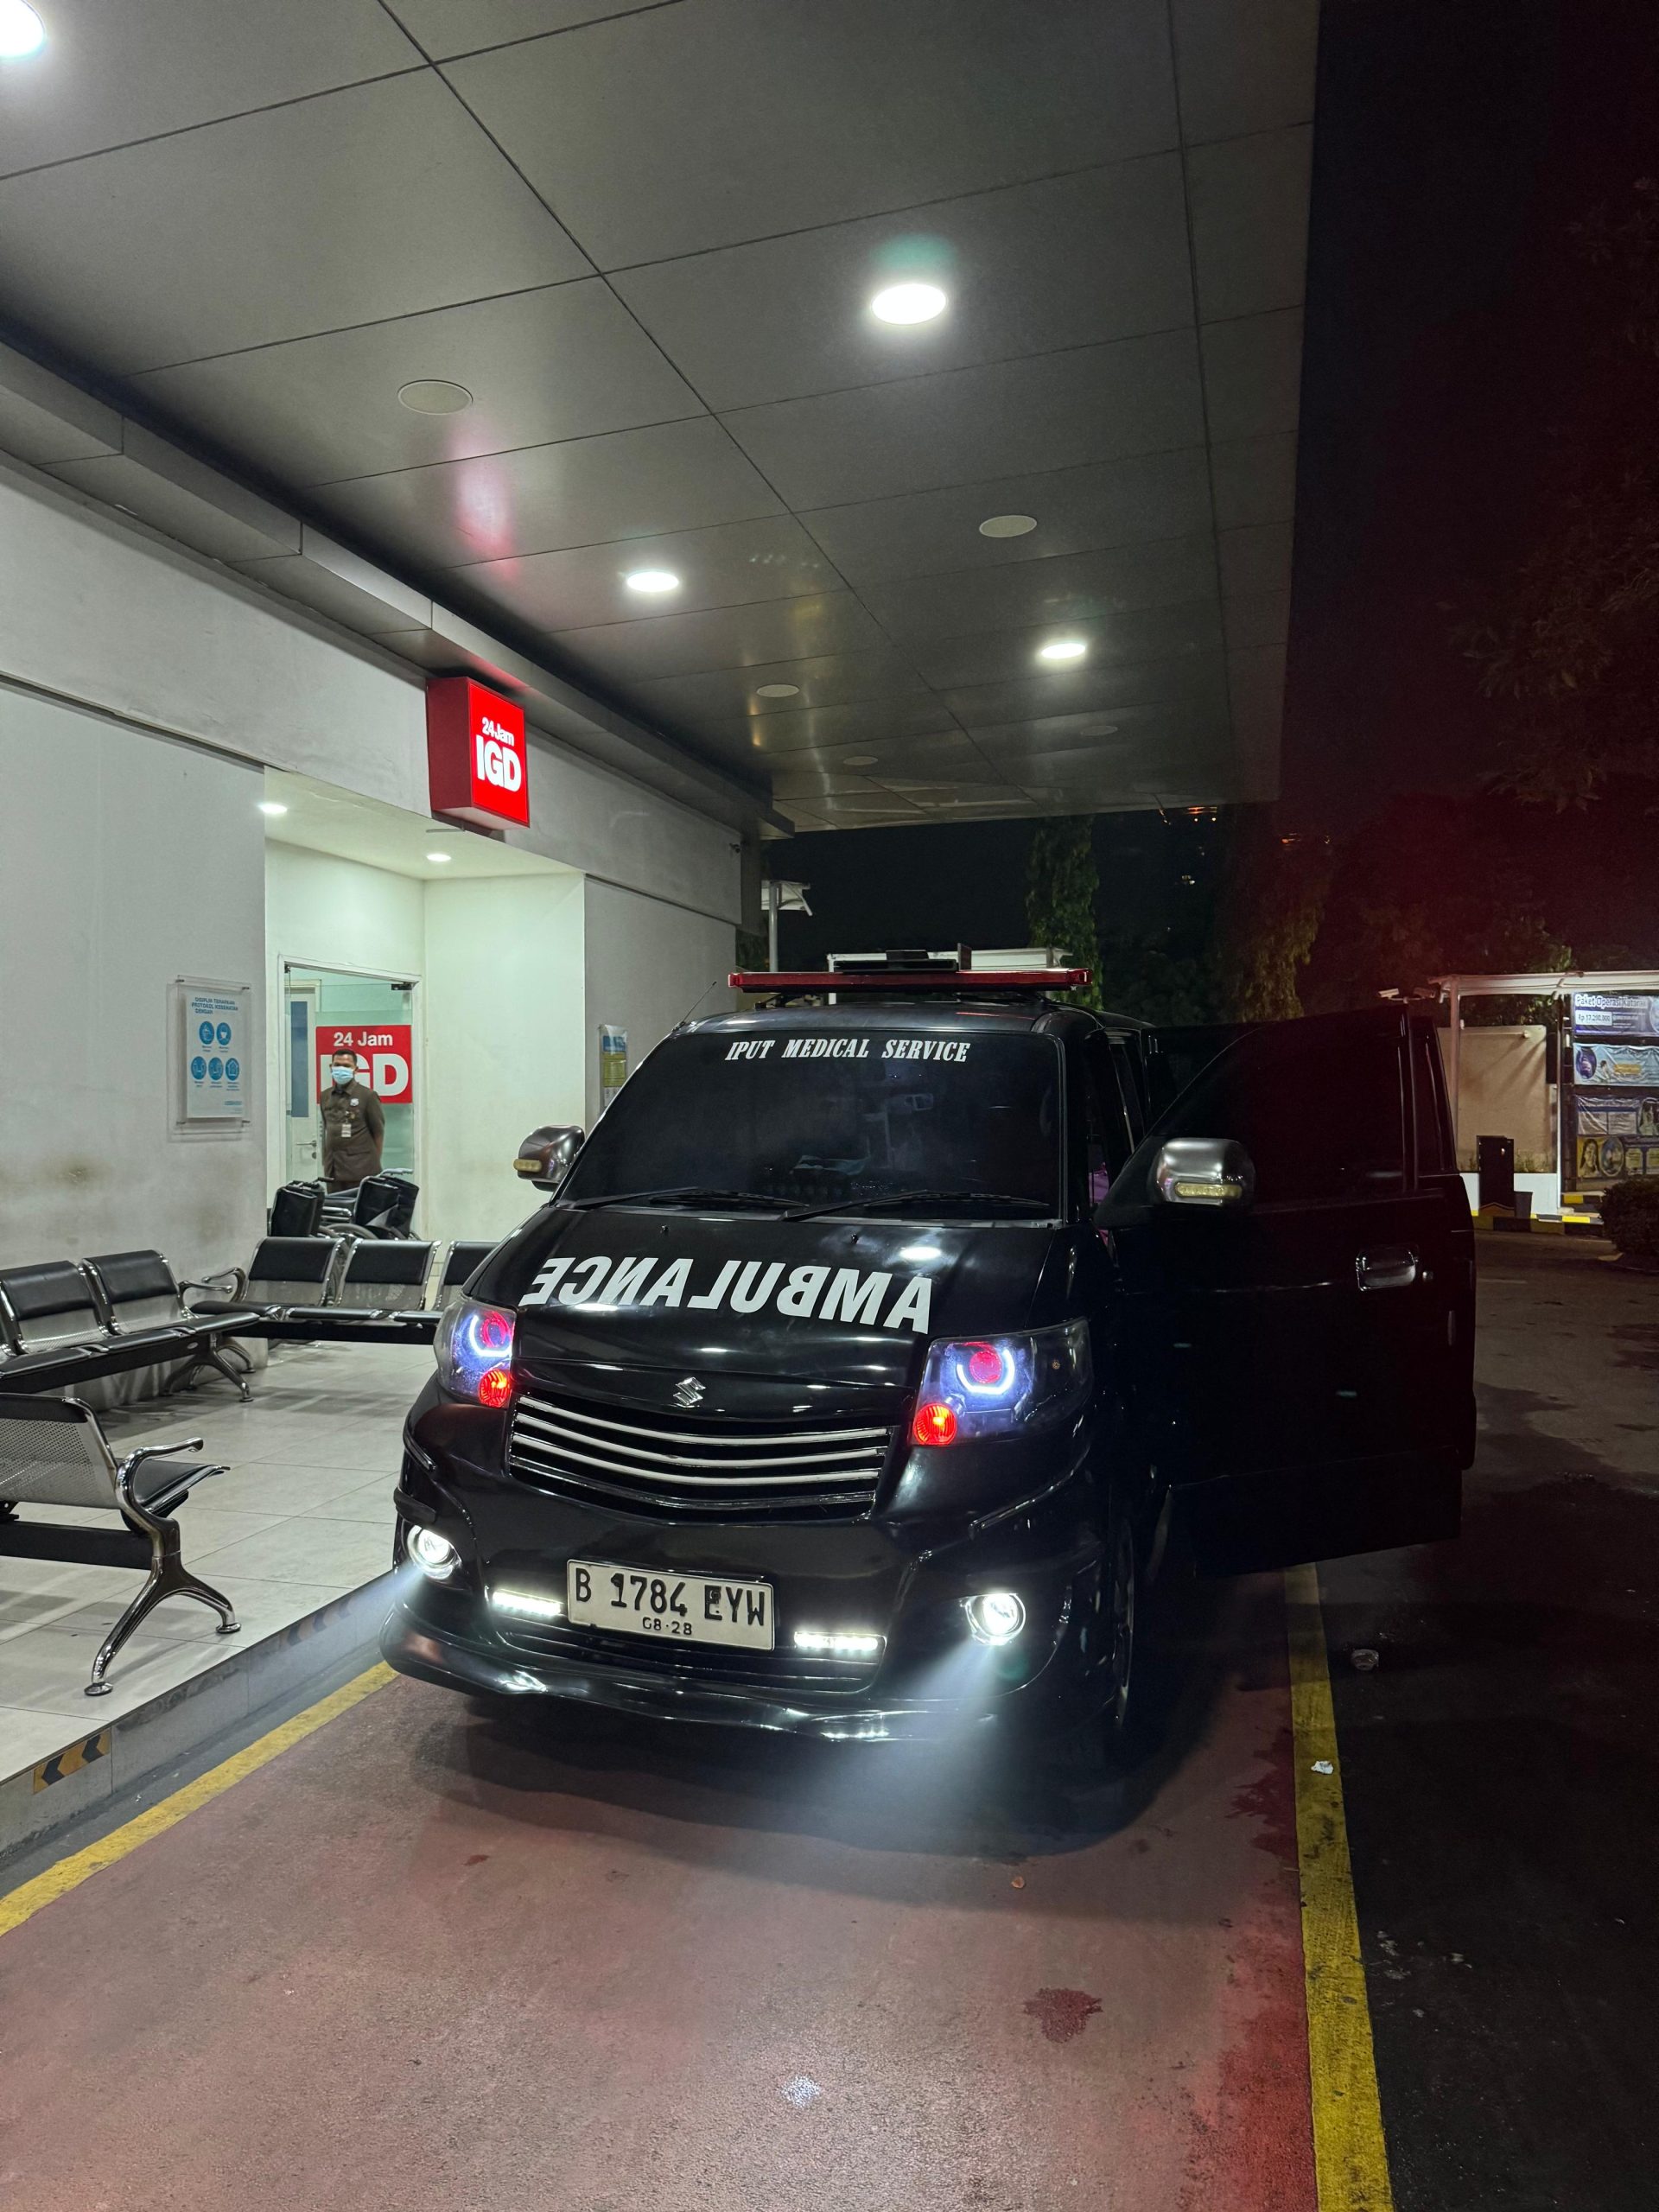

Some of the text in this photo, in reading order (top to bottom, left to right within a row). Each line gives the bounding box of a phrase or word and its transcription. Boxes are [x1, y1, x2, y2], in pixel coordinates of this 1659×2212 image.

[475, 734, 522, 792] IGD
[1575, 994, 1596, 1007] Paket
[1596, 995, 1621, 1009] Operasi
[334, 1032, 393, 1046] 24 Jam
[725, 1039, 971, 1062] IPUT MEDICAL SERVICE
[575, 1567, 765, 1626] B 1784 EYW
